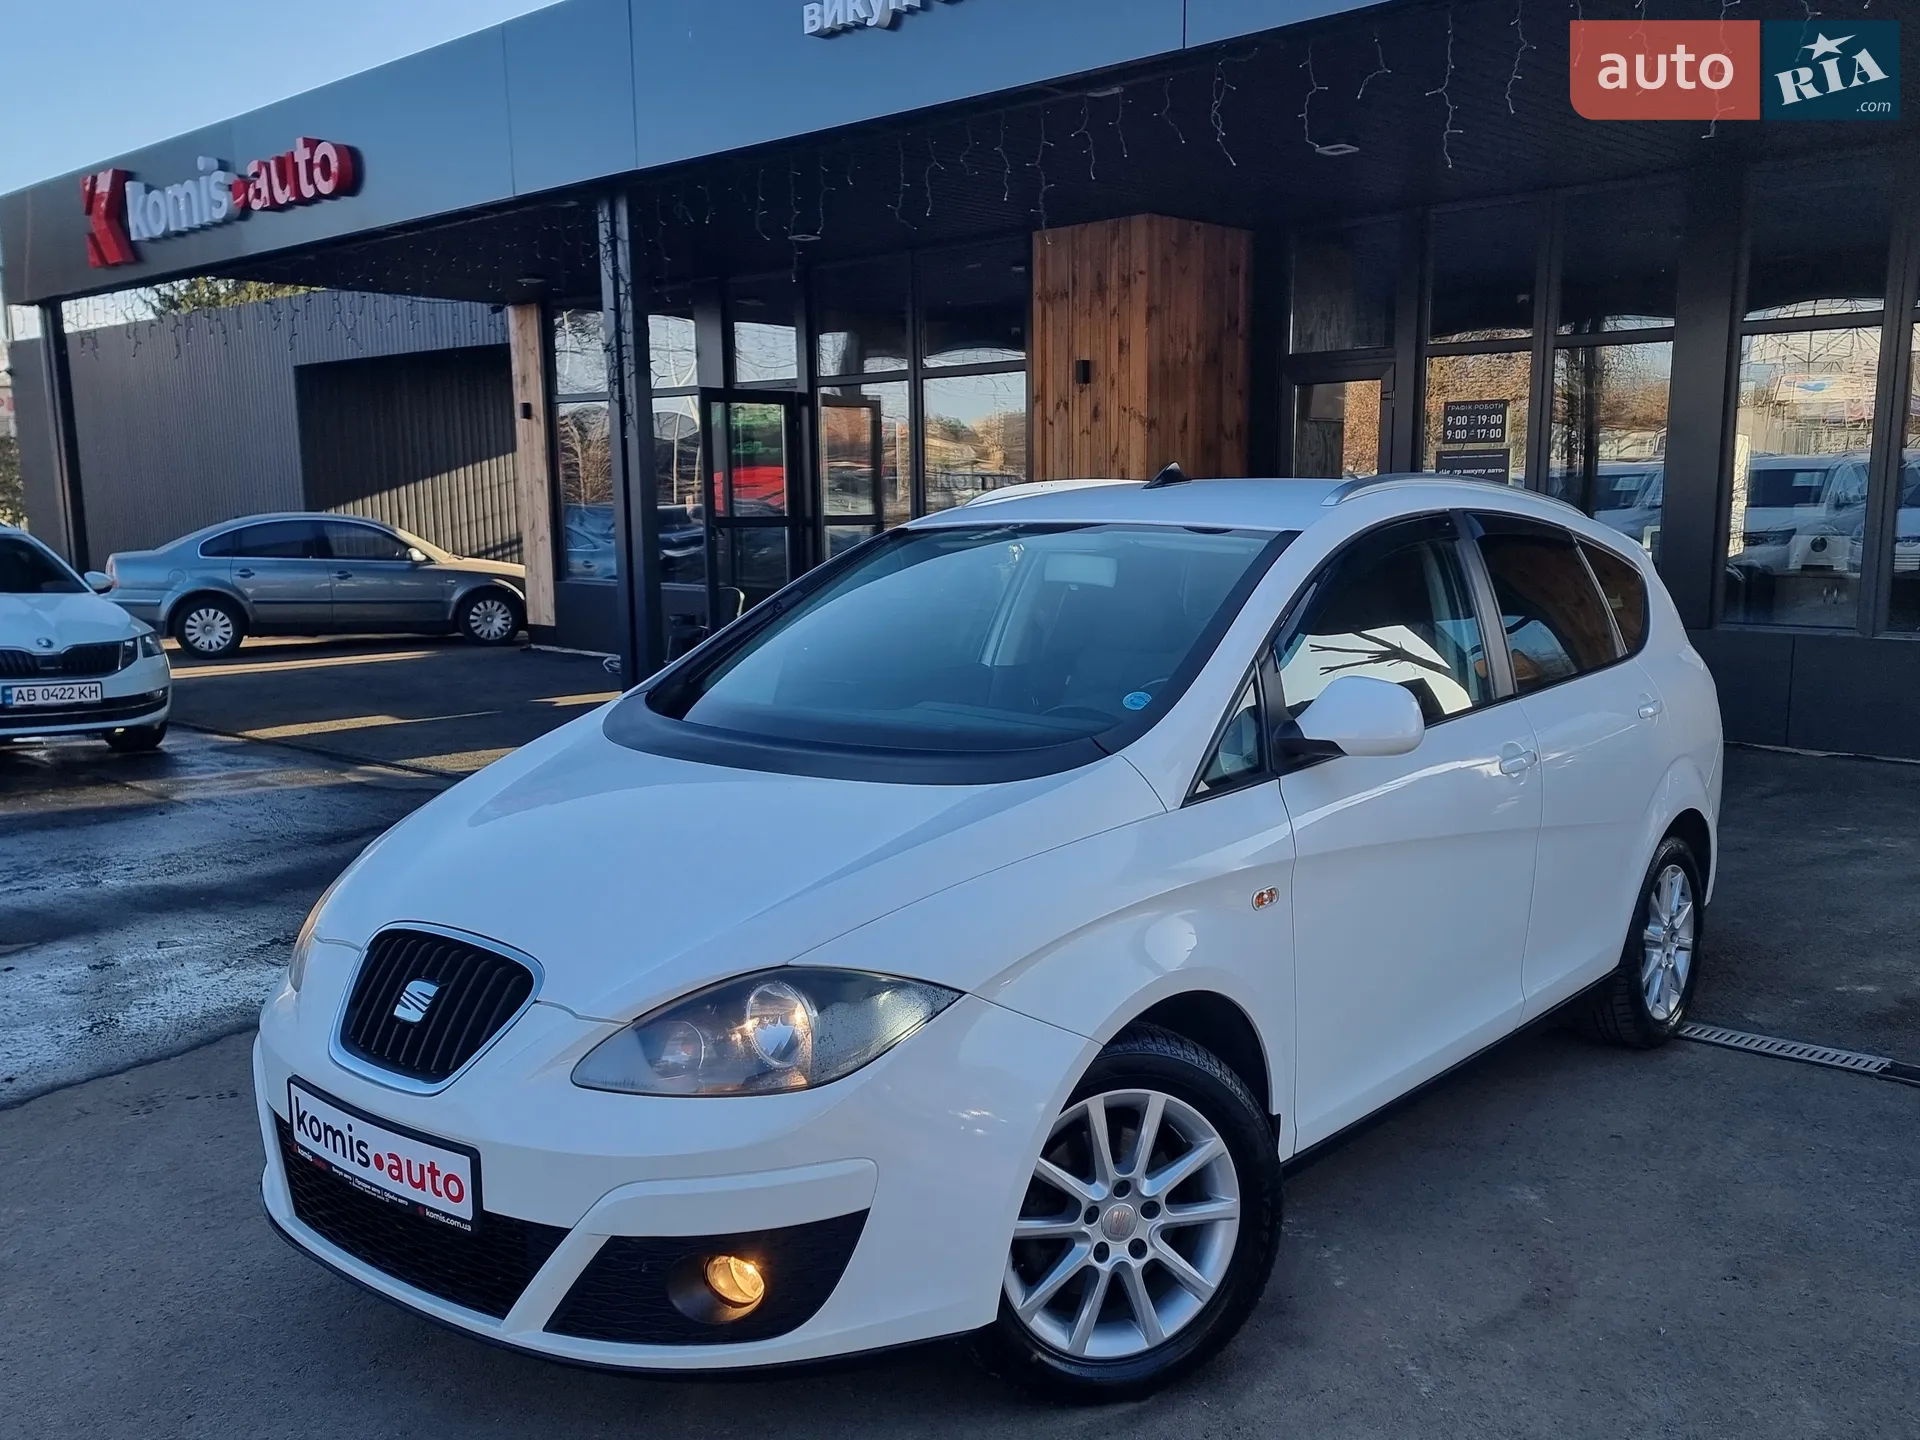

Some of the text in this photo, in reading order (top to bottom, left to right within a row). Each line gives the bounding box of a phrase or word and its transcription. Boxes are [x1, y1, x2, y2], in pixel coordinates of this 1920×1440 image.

[803, 0, 921, 34] вику
[1447, 415, 1468, 426] 9:00
[1477, 414, 1503, 425] 19:00
[1446, 429, 1467, 440] 9:00
[1476, 428, 1502, 439] 17:00
[15, 689, 37, 702] AB
[41, 687, 75, 701] 0422
[78, 686, 98, 699] KH
[425, 1207, 472, 1232] komis.com.ua
